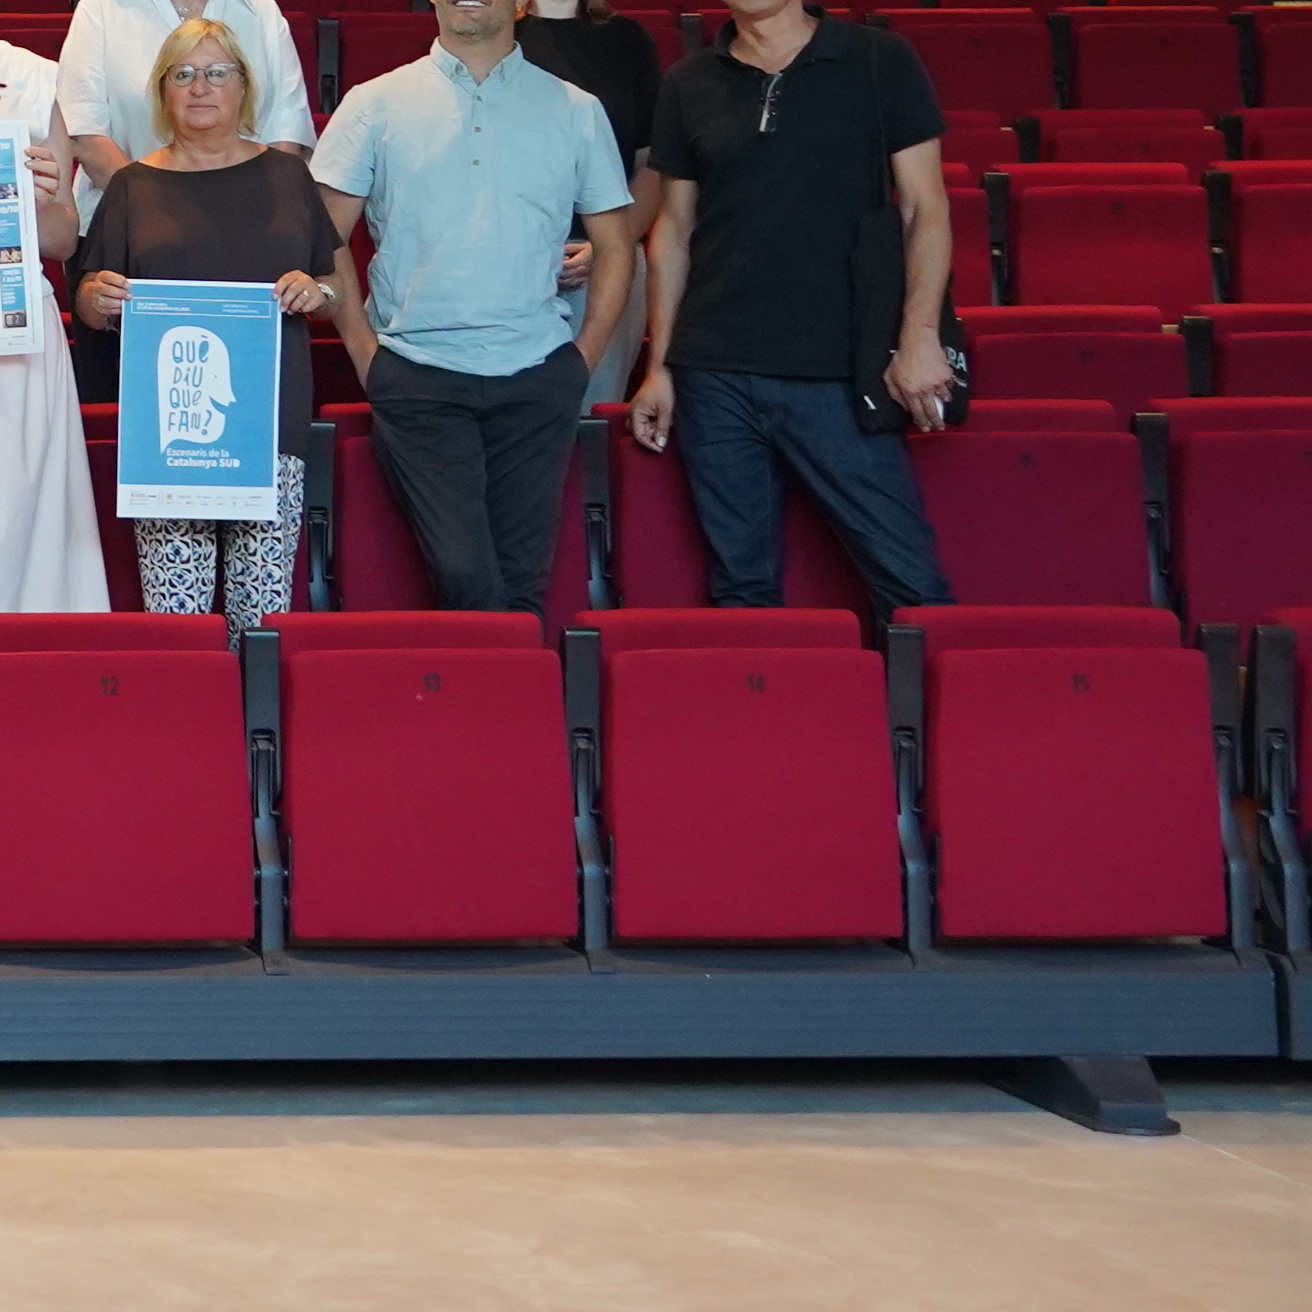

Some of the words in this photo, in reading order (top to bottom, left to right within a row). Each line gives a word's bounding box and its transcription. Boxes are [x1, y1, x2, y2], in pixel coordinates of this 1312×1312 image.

[166, 447, 207, 457] Escenaris
[208, 448, 220, 458] de
[221, 448, 230, 458] la
[166, 456, 217, 469] Catalunya
[219, 458, 241, 468] SUD
[100, 675, 120, 695] 12
[745, 673, 765, 693] 14
